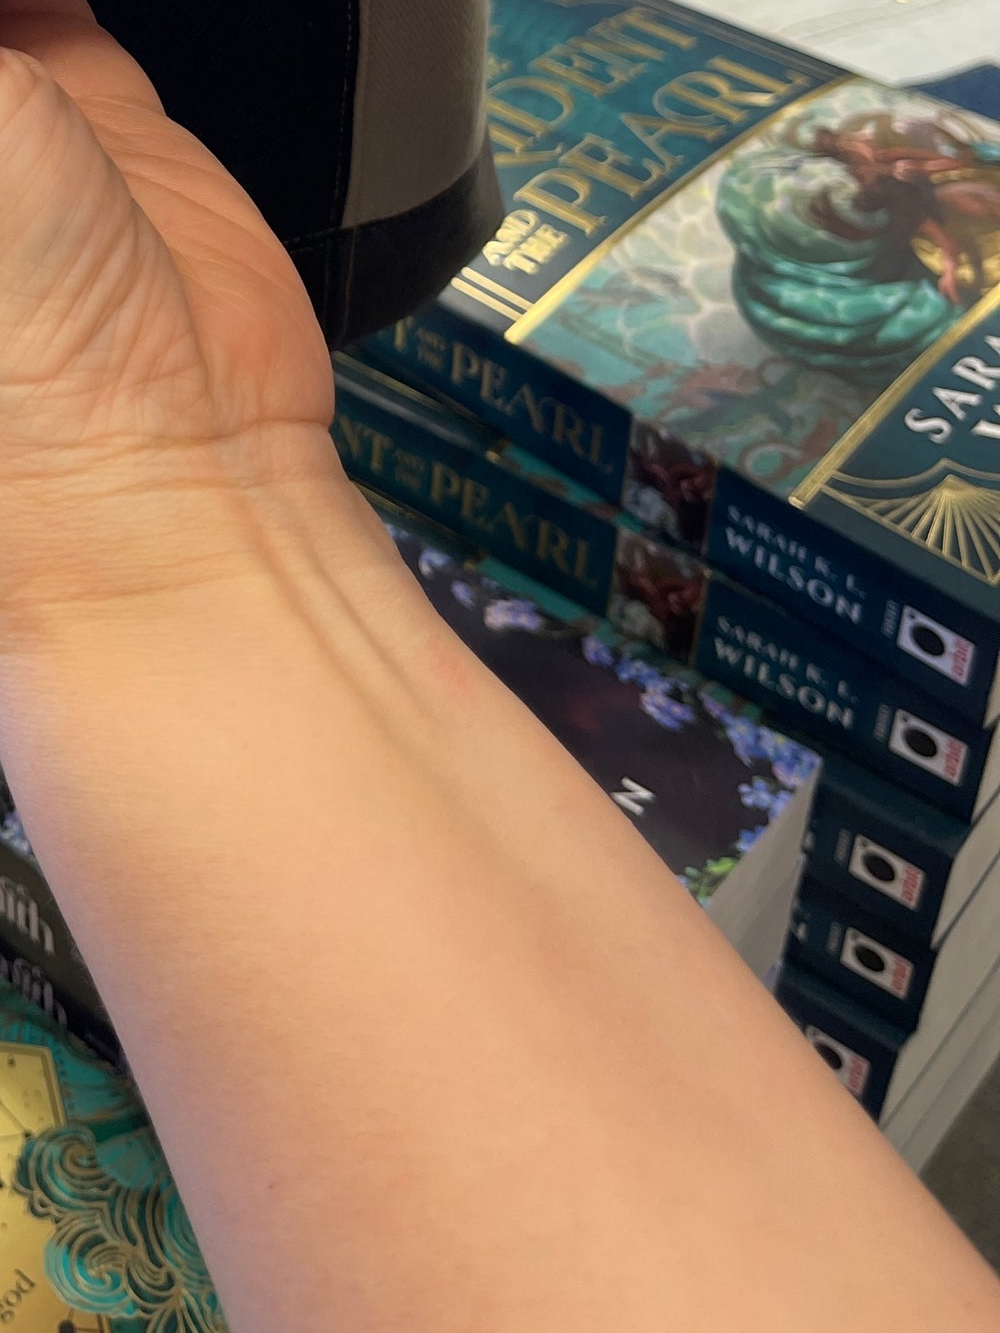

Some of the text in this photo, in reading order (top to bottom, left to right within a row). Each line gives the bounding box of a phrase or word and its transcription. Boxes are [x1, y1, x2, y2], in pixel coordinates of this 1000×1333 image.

[487, 6, 697, 166] IDENT
[512, 56, 812, 239] PEARL
[451, 340, 615, 474] PEARL
[430, 460, 600, 587] PEARL
[725, 526, 863, 624] WILSON
[727, 504, 808, 563] SARAH
[713, 635, 854, 730] WILSON
[716, 615, 799, 670] SARAH
